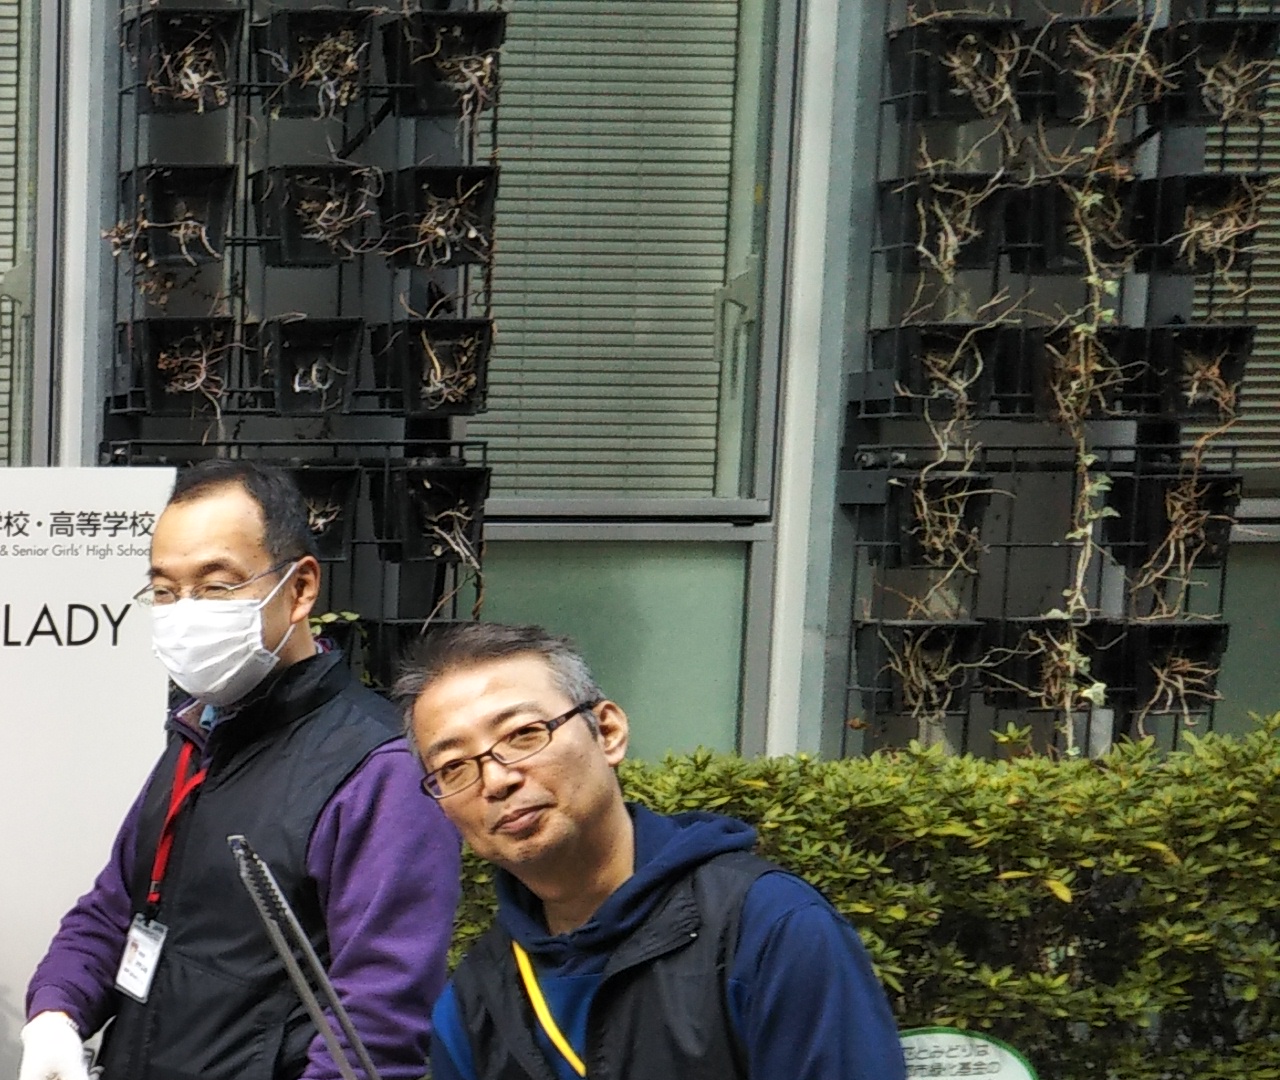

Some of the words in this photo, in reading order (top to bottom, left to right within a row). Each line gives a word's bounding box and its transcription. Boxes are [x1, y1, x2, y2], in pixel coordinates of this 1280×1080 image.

[0, 545, 8, 556] &
[11, 544, 48, 557] Senior
[86, 544, 113, 560] High
[117, 544, 152, 557] Schoo
